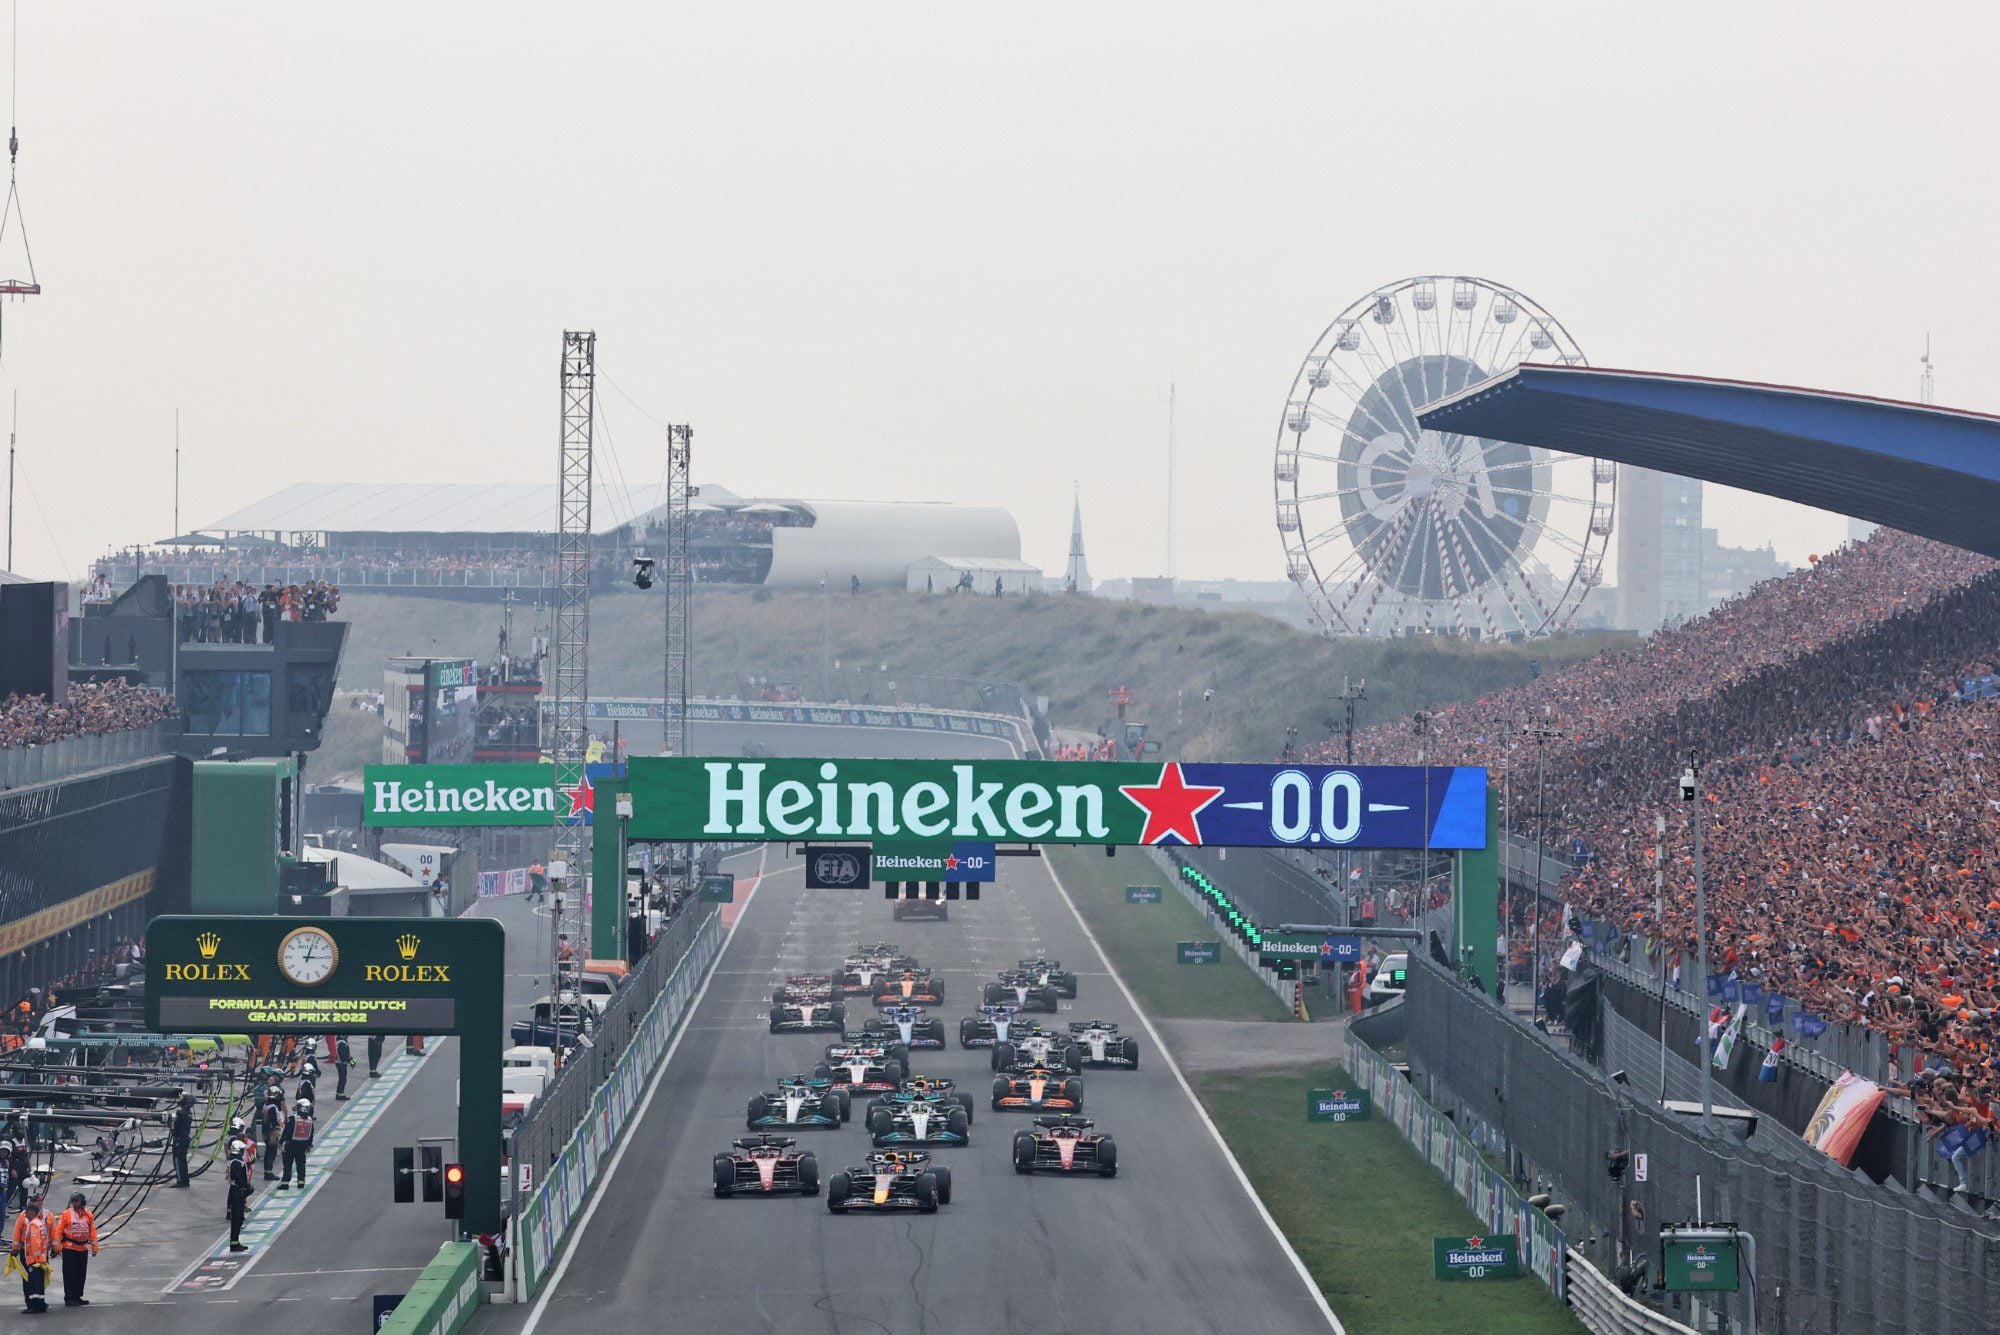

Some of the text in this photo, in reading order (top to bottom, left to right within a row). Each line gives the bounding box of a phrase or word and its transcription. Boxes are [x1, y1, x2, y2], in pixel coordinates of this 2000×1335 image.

[607, 704, 648, 718] Heineken
[686, 706, 719, 719] eineken
[372, 780, 554, 813] Heineken
[703, 762, 1362, 843] Heineken 0.0
[875, 856, 942, 868] Heineken
[484, 873, 499, 896] BWT
[1262, 940, 1318, 954] Heineken
[165, 963, 251, 981] ROLEX
[365, 965, 450, 982] ROLEX
[209, 999, 407, 1010] FORMULA 1 HEINEKEN DUTCH
[248, 1012, 367, 1023] GRAND PRIX 2022
[1319, 1101, 1360, 1112] Heineken
[1449, 1251, 1503, 1264] Heineken
[1686, 1254, 1716, 1262] Heineken
